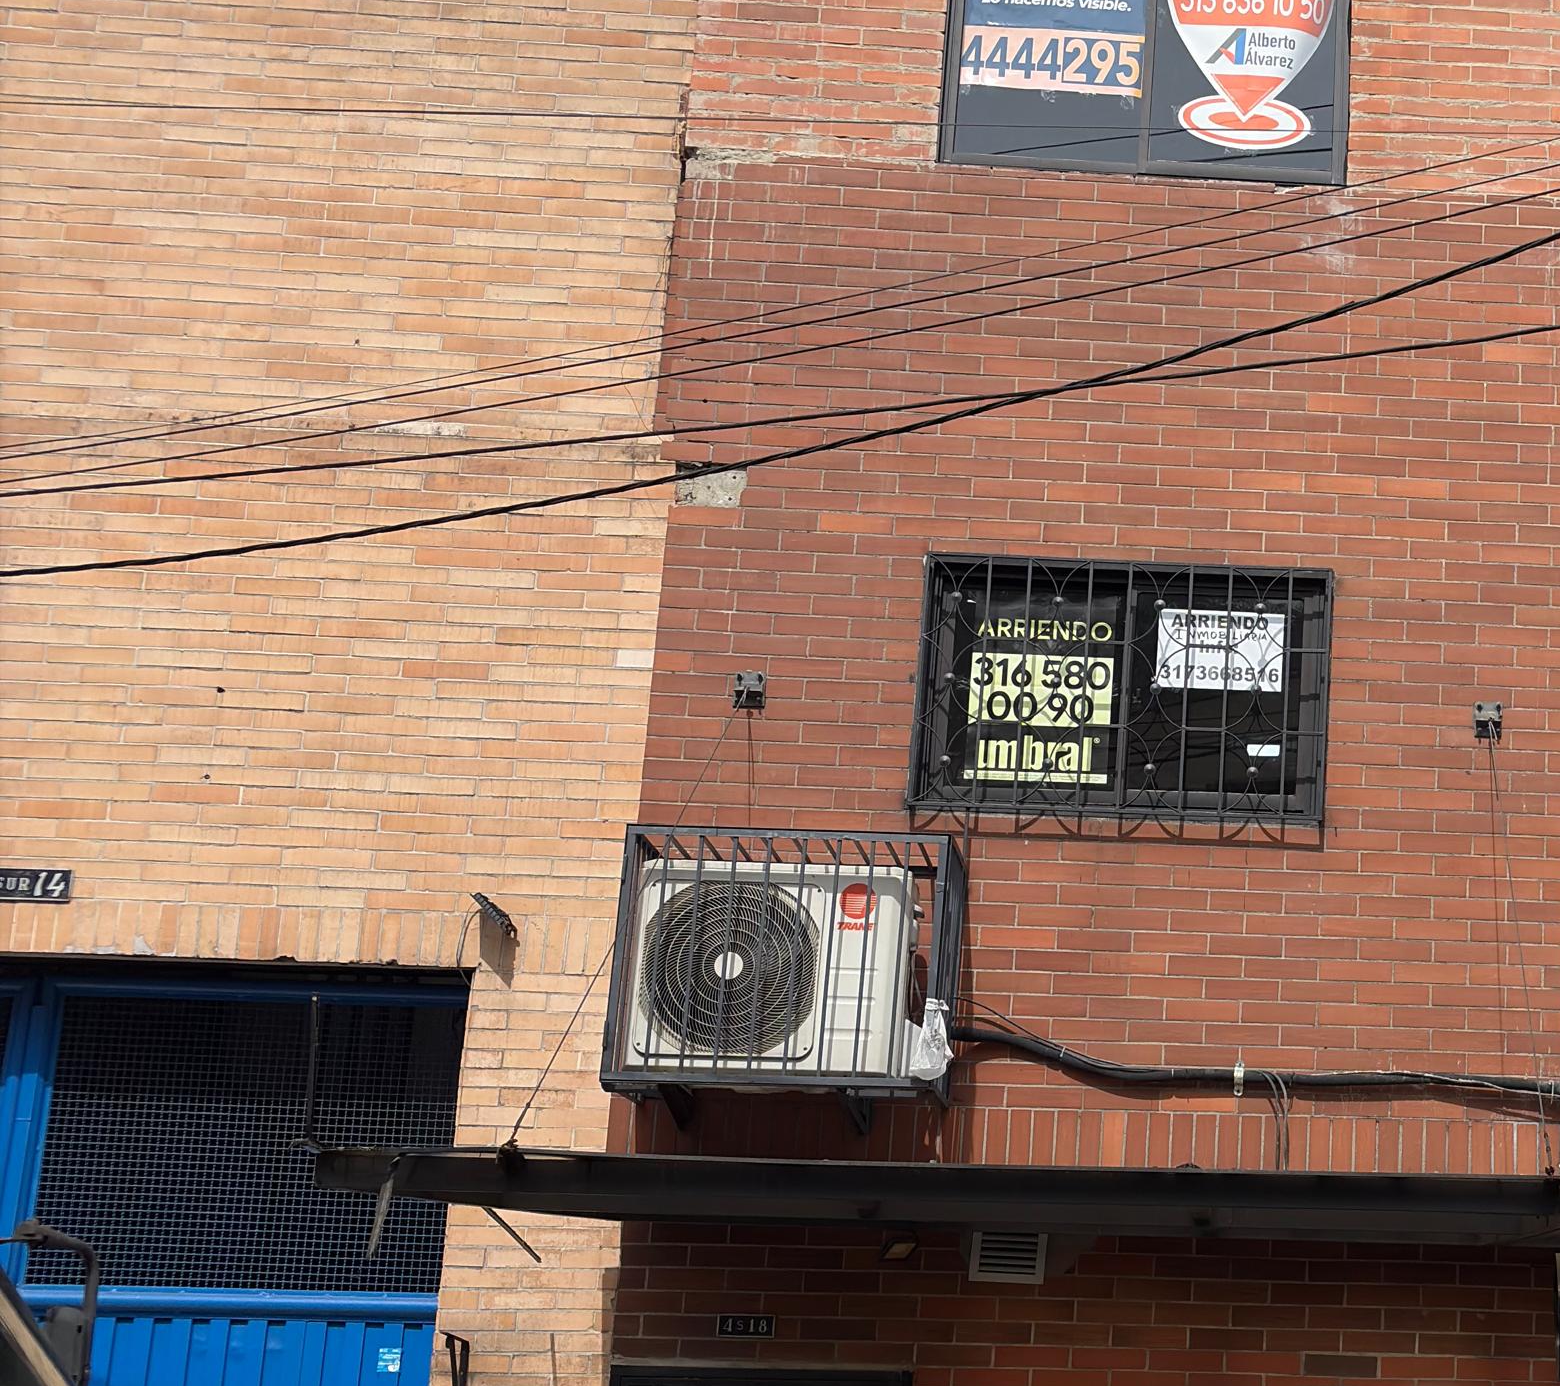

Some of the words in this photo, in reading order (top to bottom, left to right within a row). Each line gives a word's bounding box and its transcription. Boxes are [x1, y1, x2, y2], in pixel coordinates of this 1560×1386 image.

[1248, 33, 1295, 50] Alberto
[961, 35, 1140, 86] 4444295
[1245, 48, 1294, 69] Álvarez
[978, 618, 1112, 642] ARRIENDO
[1171, 614, 1269, 630] ARRIENDO
[973, 657, 1032, 687] 316
[1041, 660, 1111, 690] 580
[987, 691, 1038, 721] 00
[1048, 693, 1094, 724] 90
[977, 734, 1093, 771] umbral
[33, 872, 66, 897] 14
